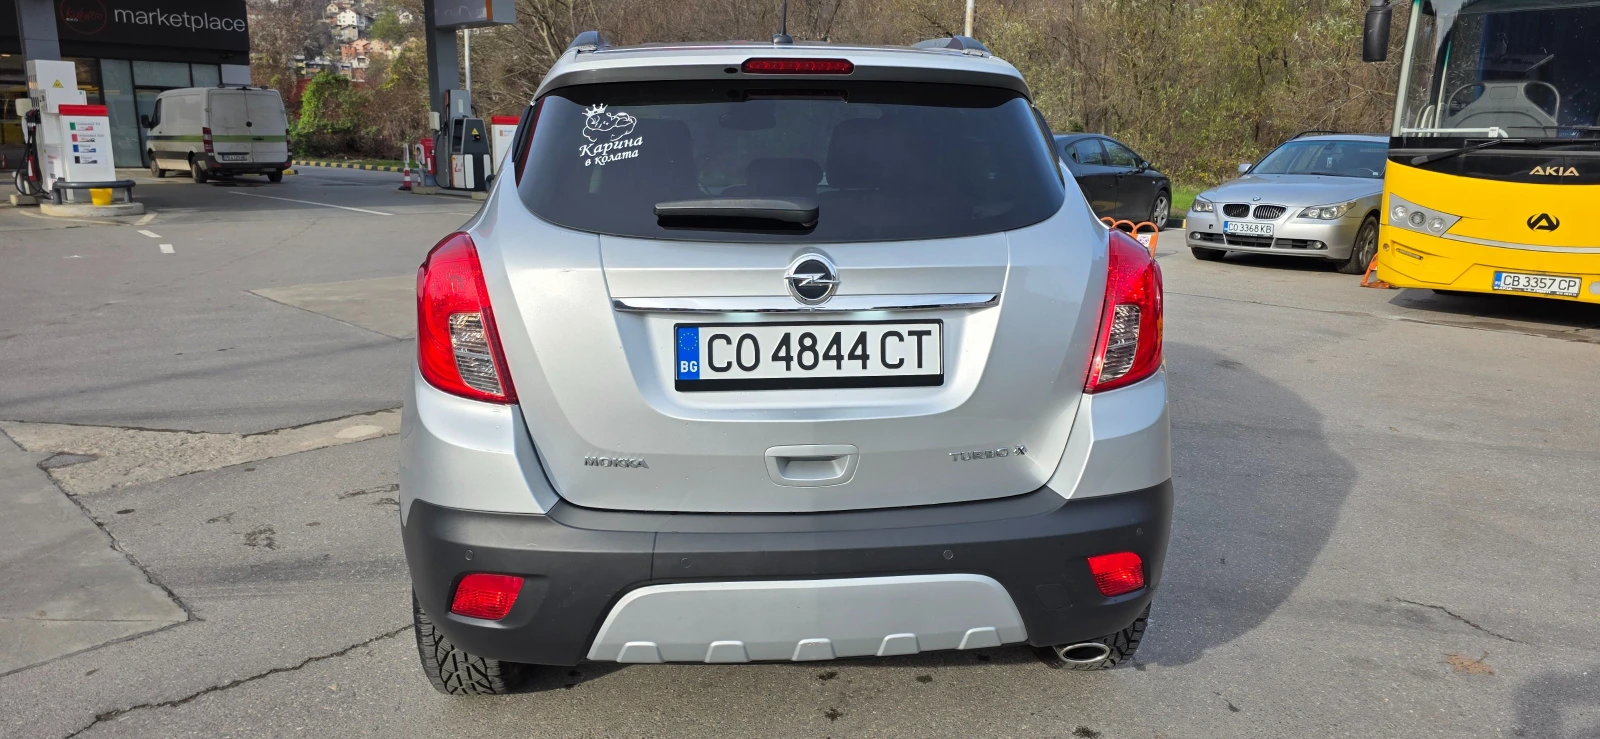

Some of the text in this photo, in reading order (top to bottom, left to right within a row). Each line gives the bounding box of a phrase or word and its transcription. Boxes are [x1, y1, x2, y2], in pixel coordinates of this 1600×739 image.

[114, 8, 246, 32] marketplace
[579, 136, 643, 157] Карина
[1529, 165, 1580, 177] AKIA
[1239, 224, 1259, 233] 3368
[1260, 225, 1272, 234] KB
[1503, 275, 1521, 287] CB
[1522, 276, 1557, 290] 3357
[1558, 279, 1577, 291] CP
[707, 329, 932, 373] CO 4844 CT
[680, 360, 698, 373] BG
[584, 455, 650, 469] MOKKA
[948, 447, 1009, 462] TURBO
